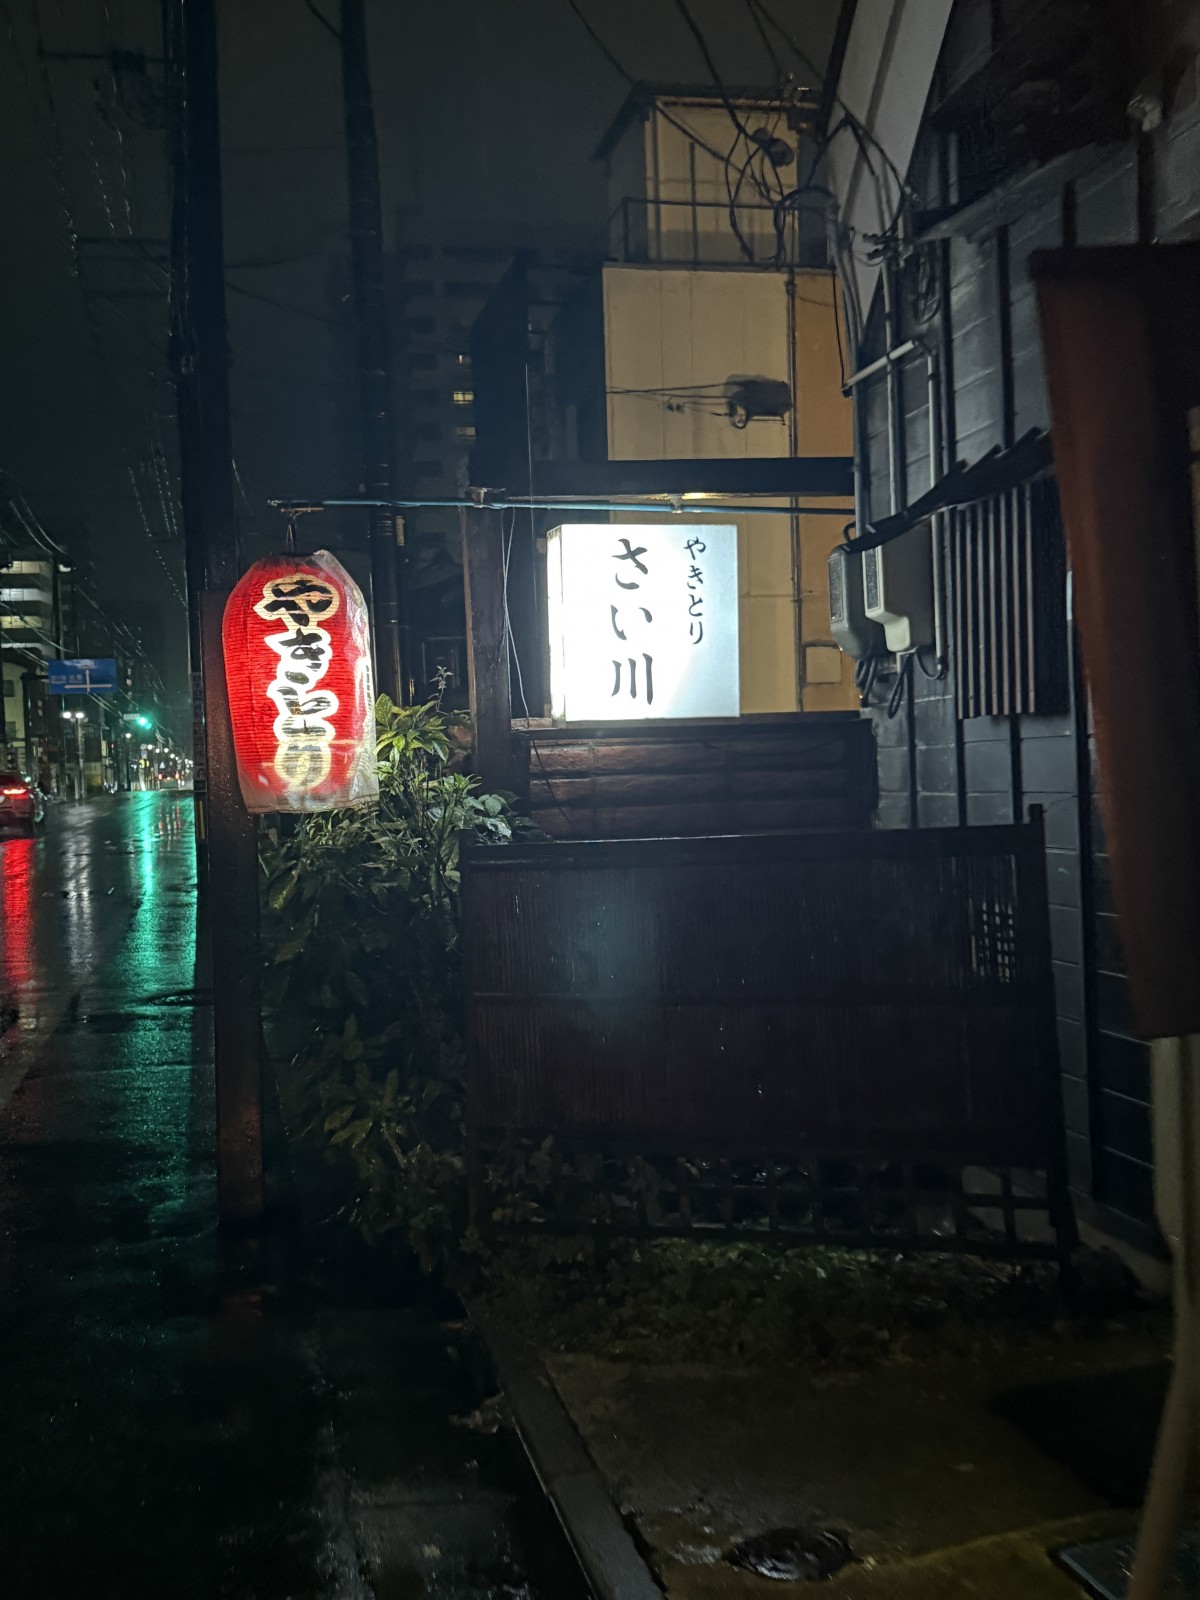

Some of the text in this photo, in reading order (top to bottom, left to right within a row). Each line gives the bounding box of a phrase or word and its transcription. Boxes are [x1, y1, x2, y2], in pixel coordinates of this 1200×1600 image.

[610, 538, 654, 705] さい川
[683, 536, 706, 645] やきとり
[261, 578, 336, 784] やきとり
